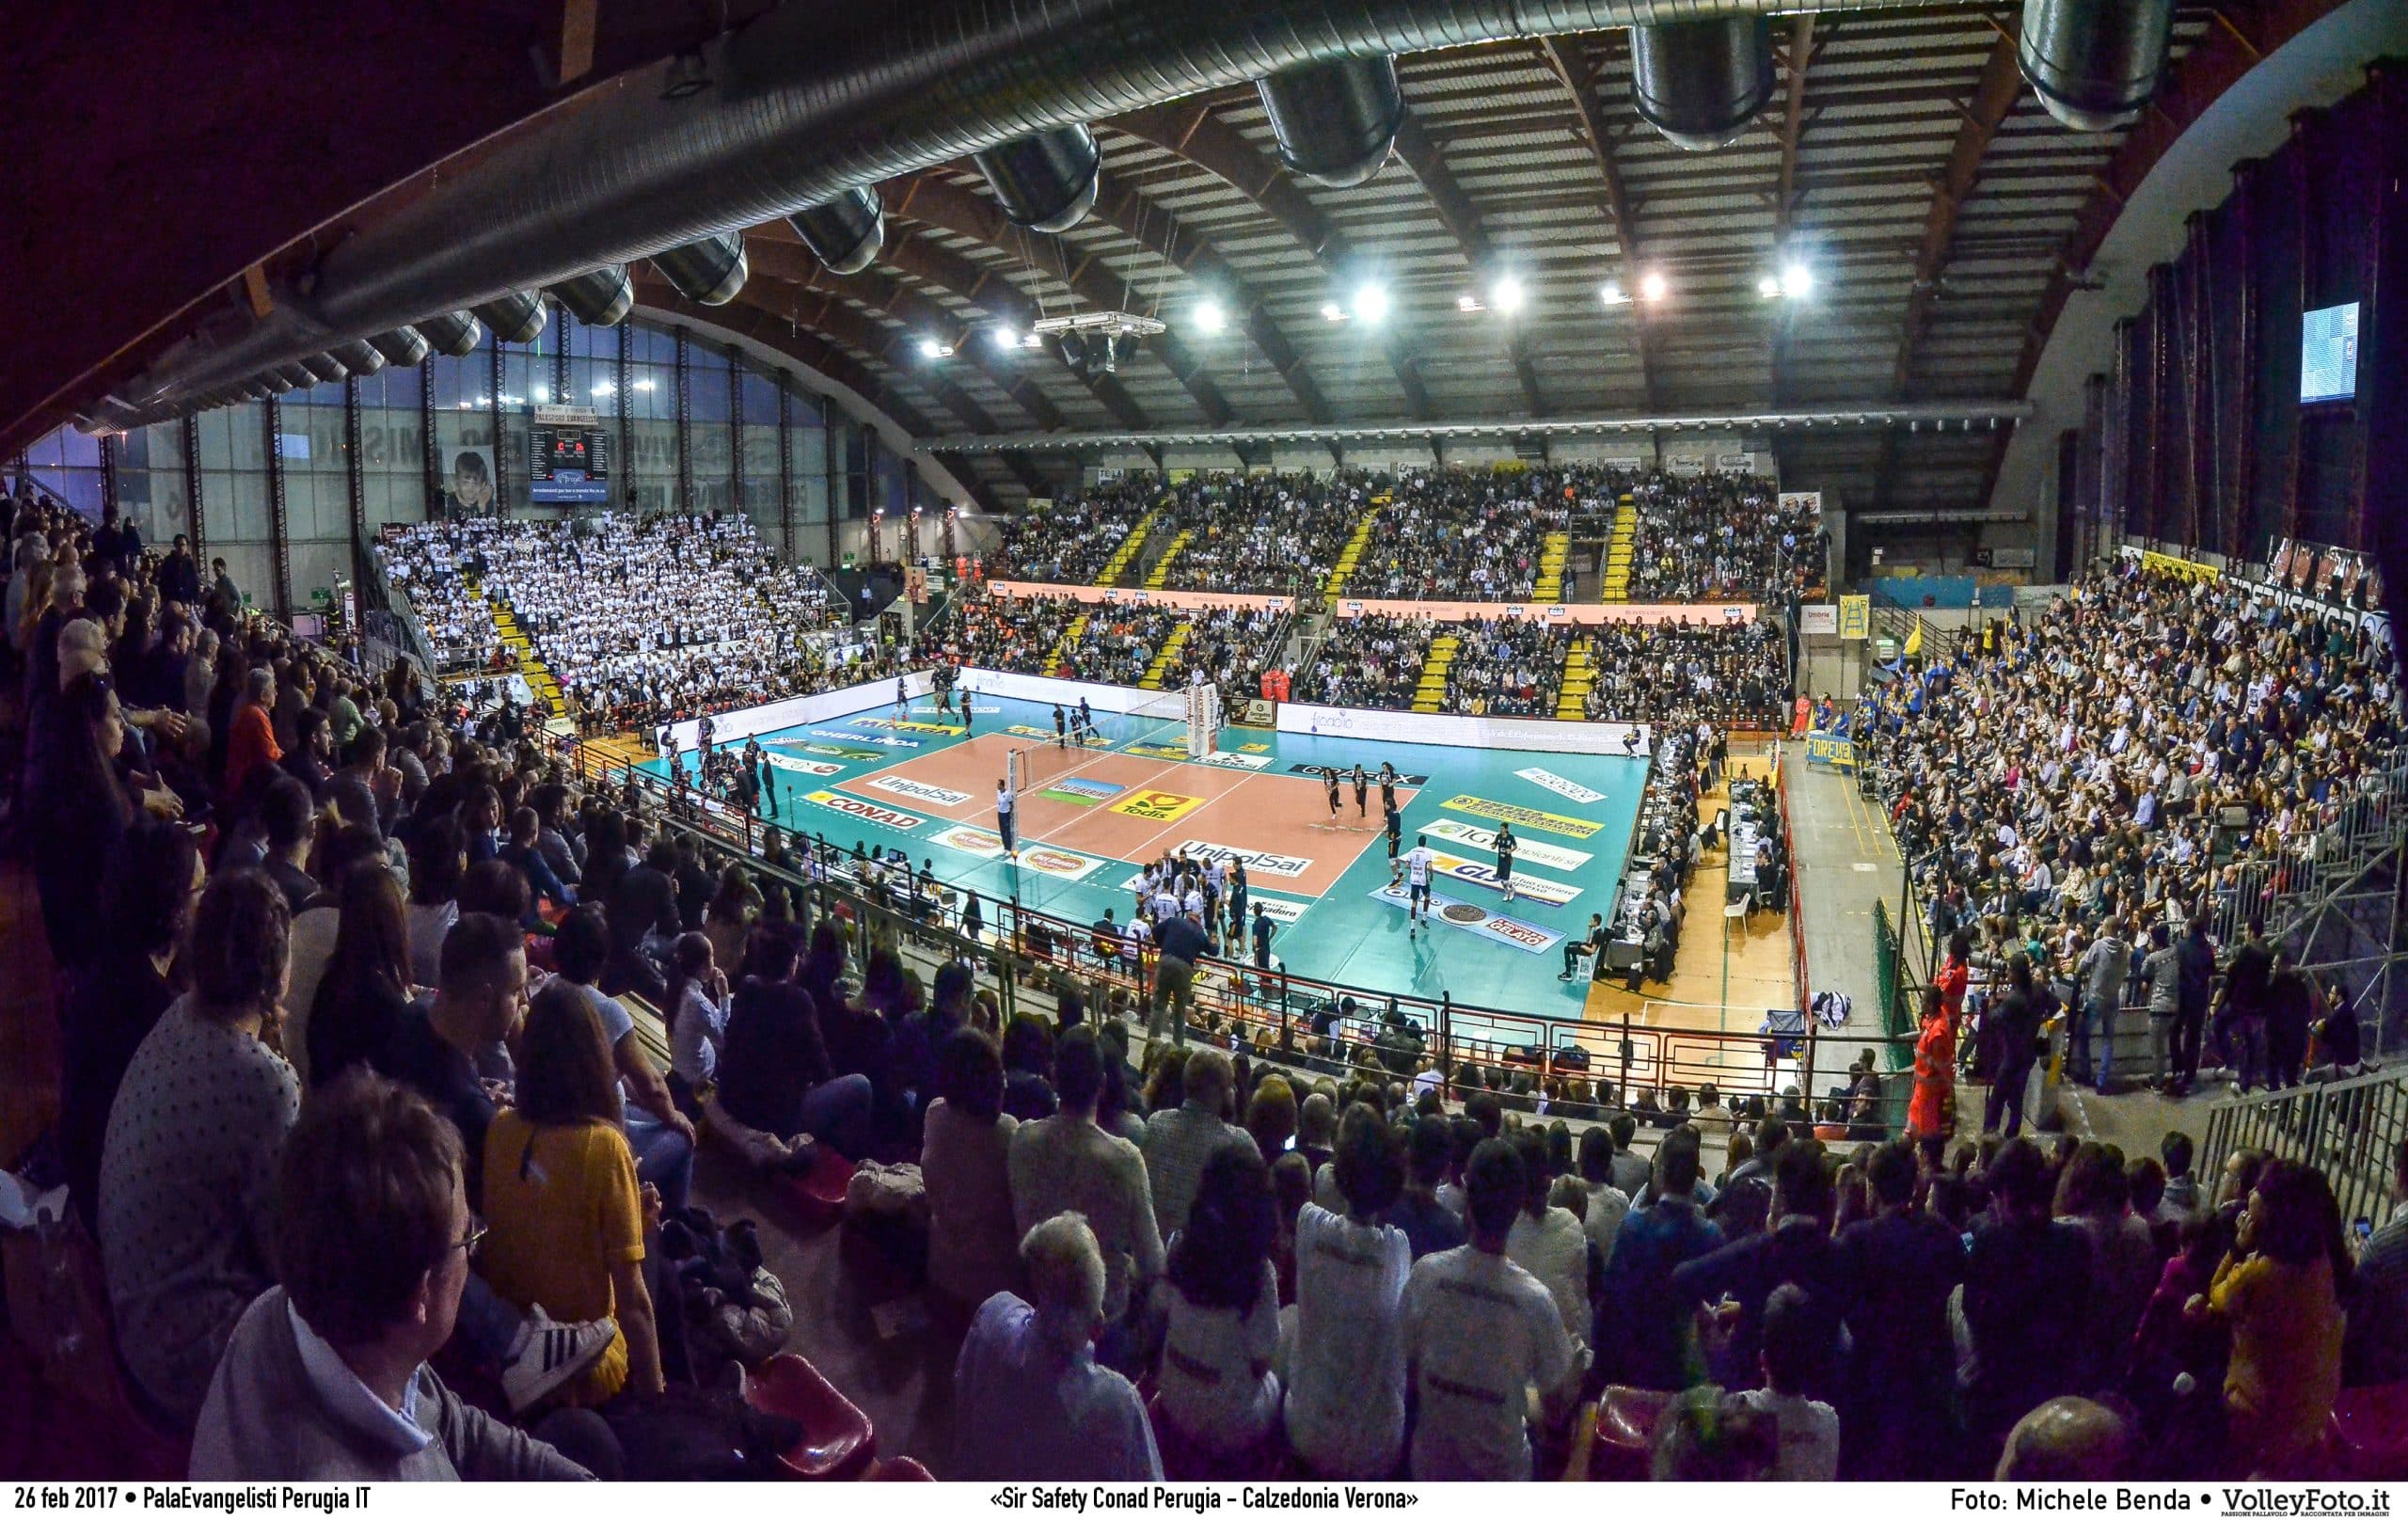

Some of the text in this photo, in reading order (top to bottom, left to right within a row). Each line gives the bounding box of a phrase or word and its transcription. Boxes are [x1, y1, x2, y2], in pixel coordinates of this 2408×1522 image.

[811, 730, 919, 748] GHERLINDA
[856, 720, 952, 736] MIKASA
[878, 775, 968, 803] UnipolSai
[827, 798, 919, 828] CONAD
[1122, 805, 1169, 819] Todis
[1181, 841, 1307, 872] UnipolSai
[1490, 922, 1540, 945] GELATO
